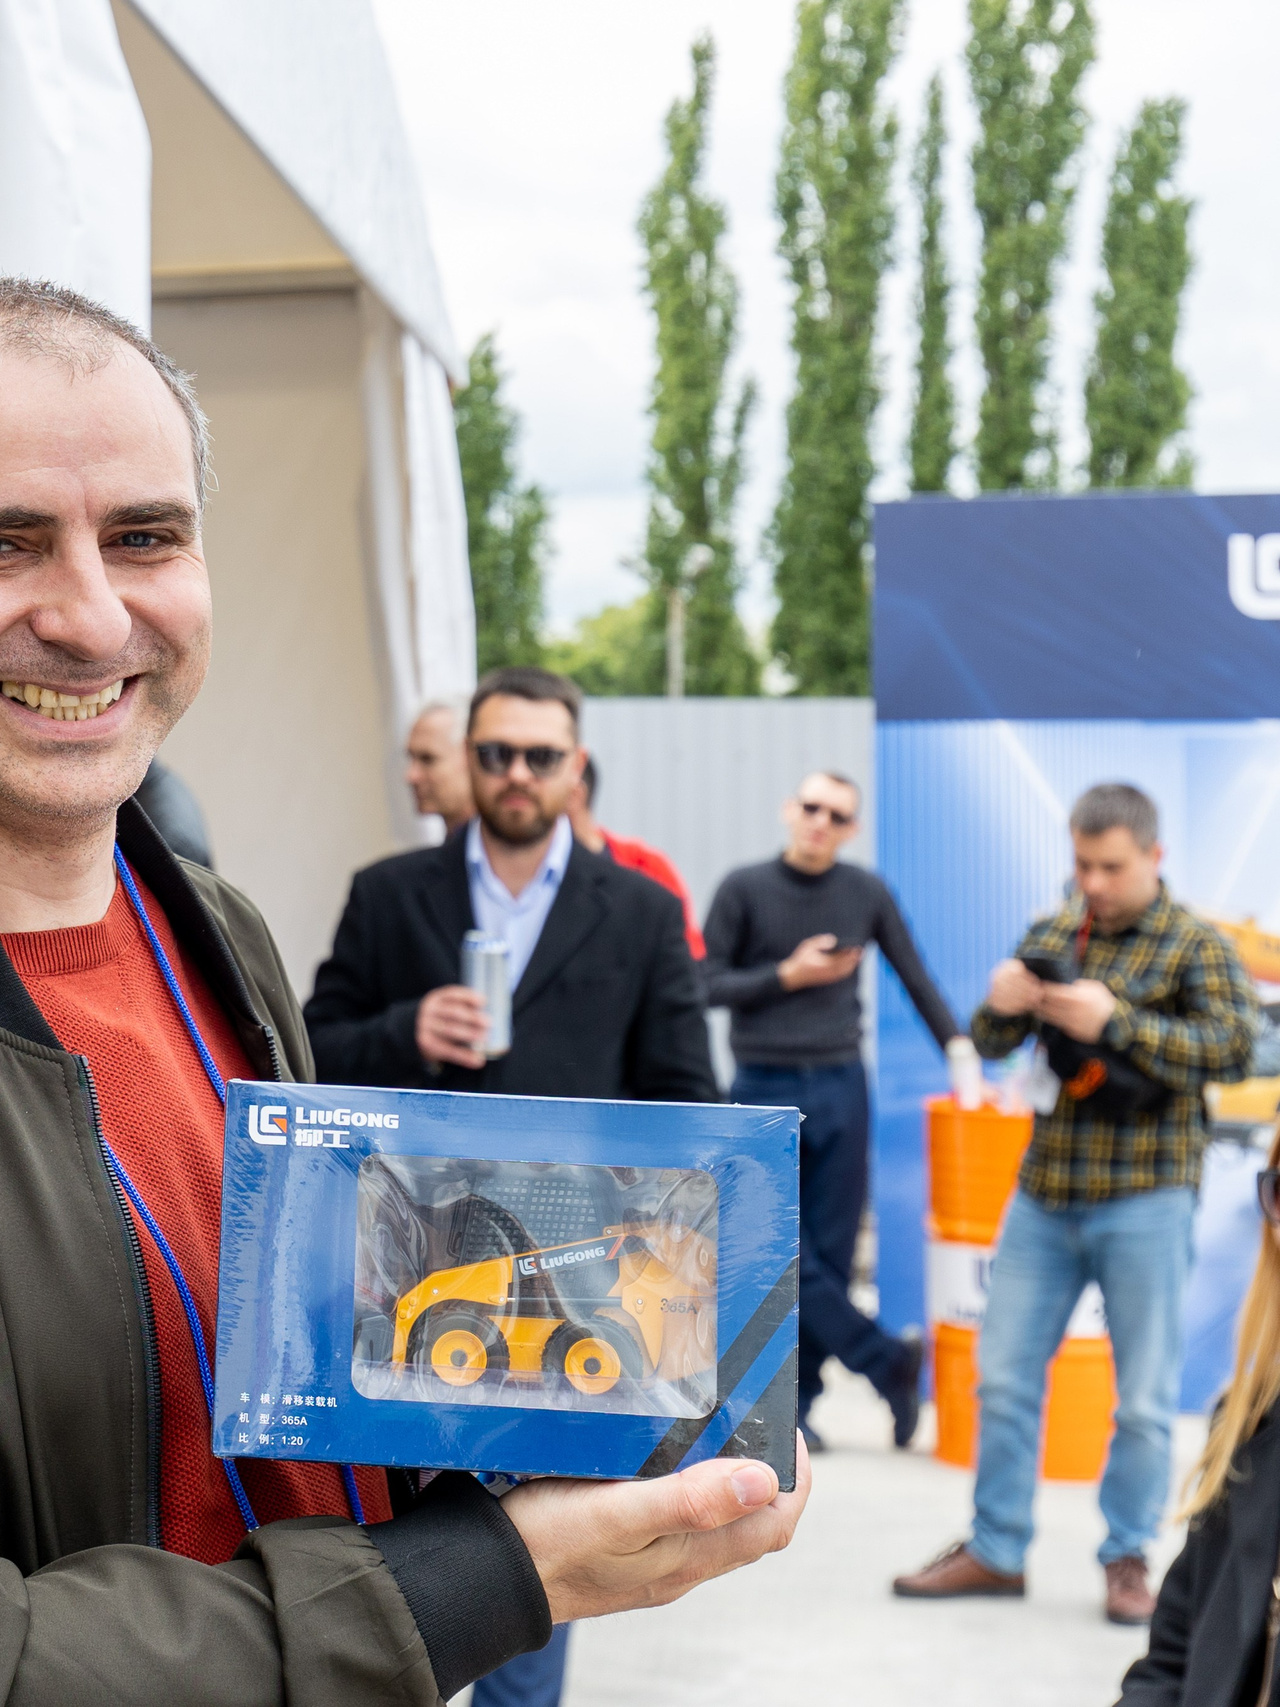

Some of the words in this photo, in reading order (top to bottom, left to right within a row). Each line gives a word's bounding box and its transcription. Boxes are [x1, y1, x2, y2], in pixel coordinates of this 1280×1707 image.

[294, 1129, 350, 1148] 柳工
[660, 1298, 698, 1315] 365A
[281, 1415, 308, 1426] 365A
[281, 1435, 304, 1446] 1:20
